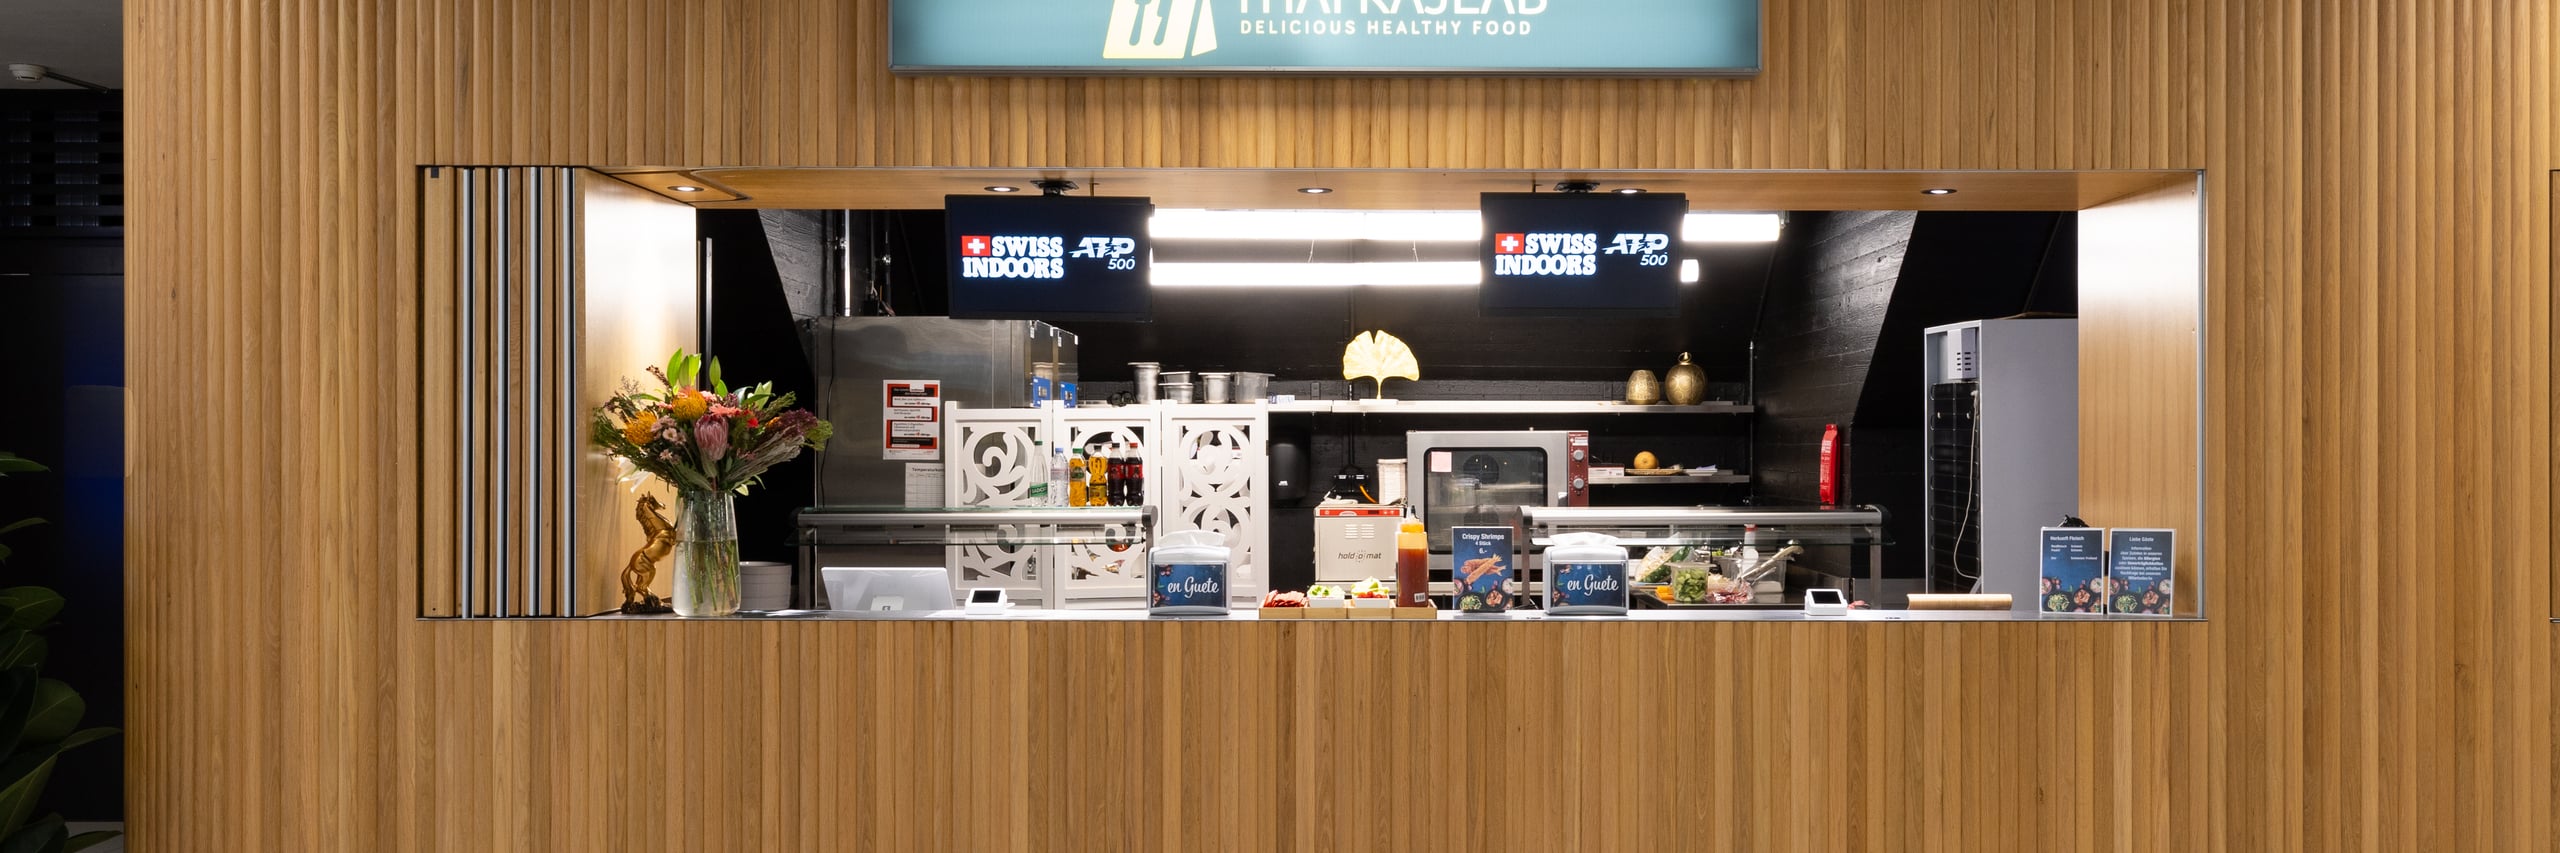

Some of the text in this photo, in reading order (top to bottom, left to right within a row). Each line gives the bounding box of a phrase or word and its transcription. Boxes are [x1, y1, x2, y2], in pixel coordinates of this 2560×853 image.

[1240, 20, 1531, 35] DELICIOUS HEALTHY FOOD
[991, 236, 1064, 257] SWISS
[1068, 237, 1136, 258] ATP
[1525, 233, 1597, 254] SWISS
[1602, 233, 1669, 255] ATP
[962, 257, 1064, 279] INDOORS
[1107, 258, 1136, 270] 500
[1495, 254, 1597, 275] INDOORS
[1639, 254, 1668, 266] 500
[1462, 533, 1505, 541] Crispy Shrimps
[1167, 576, 1219, 598] en Guete
[1567, 574, 1619, 596] en Guete
